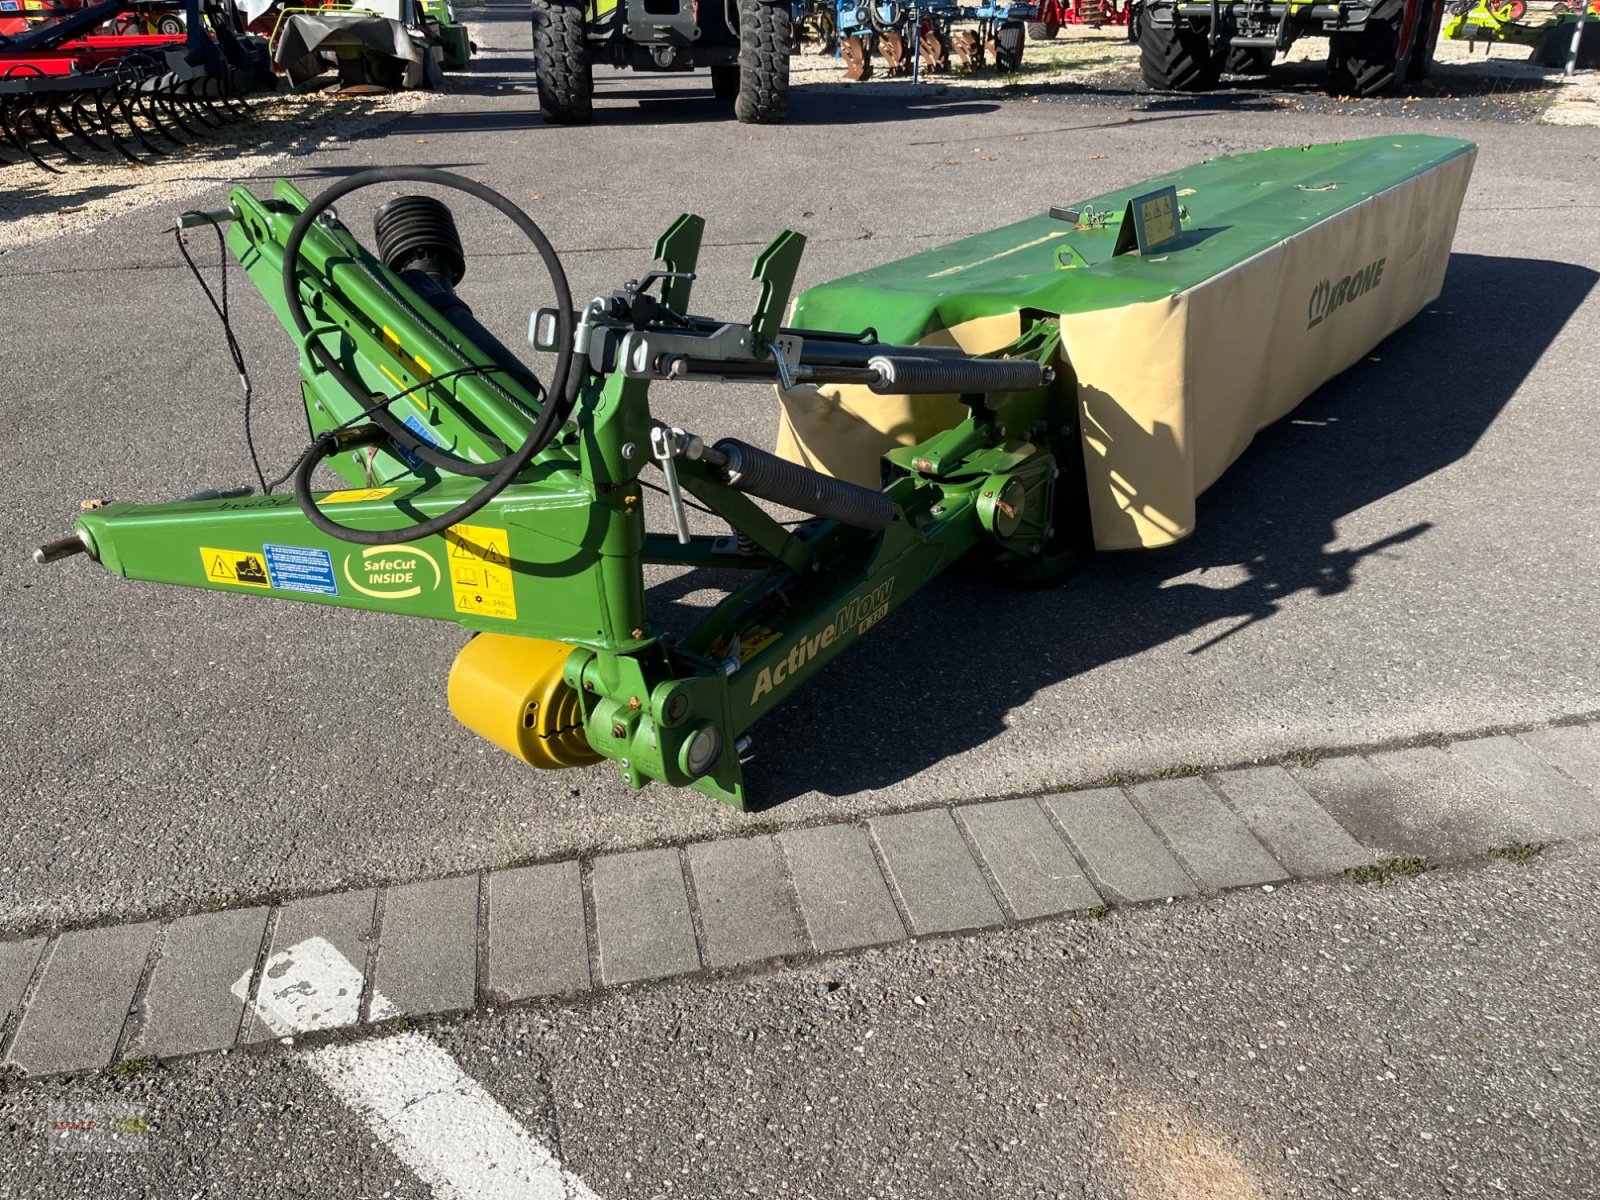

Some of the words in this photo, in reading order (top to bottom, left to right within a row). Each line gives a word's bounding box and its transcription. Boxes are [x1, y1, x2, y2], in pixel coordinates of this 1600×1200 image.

[1325, 256, 1386, 319] KRONE
[364, 559, 417, 571] SafeCut
[368, 572, 414, 584] INSIDE
[750, 576, 895, 706] ActiveMow
